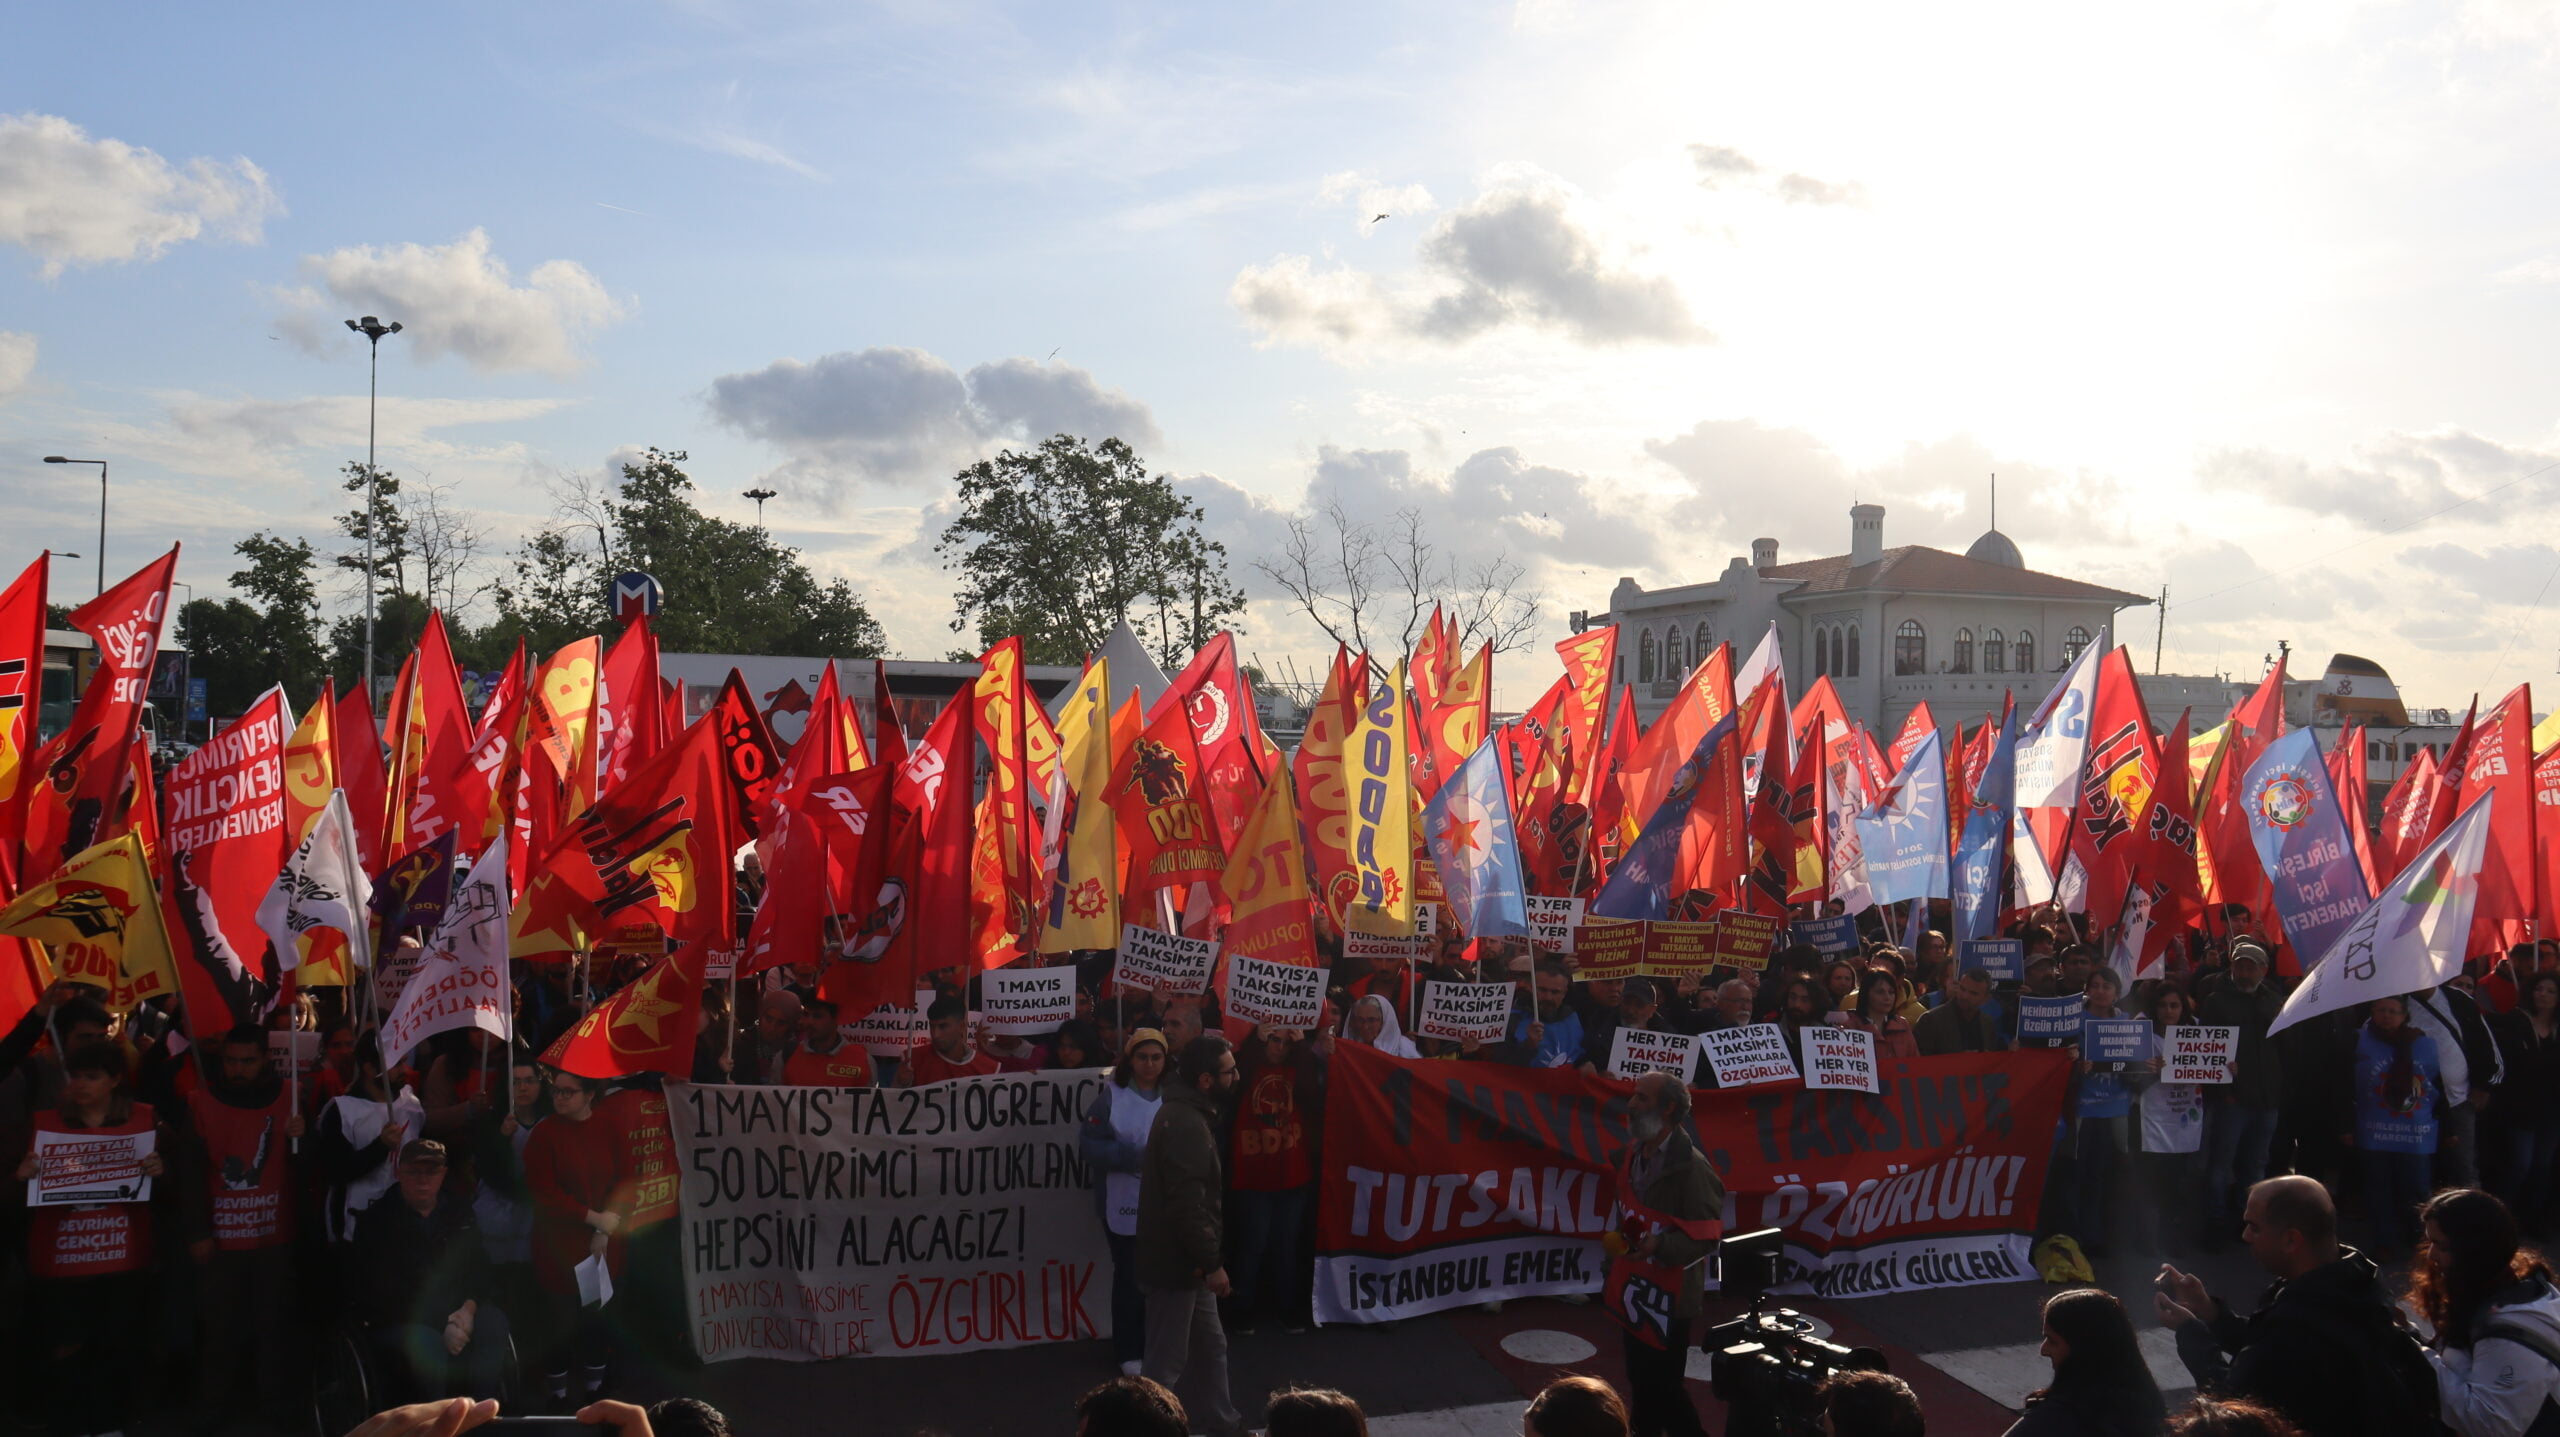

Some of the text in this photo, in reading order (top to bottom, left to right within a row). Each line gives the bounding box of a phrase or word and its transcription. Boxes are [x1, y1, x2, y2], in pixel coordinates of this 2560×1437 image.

[1543, 900, 1572, 911] YER
[1529, 911, 1567, 924] KSİM
[1538, 926, 1568, 937] YER
[1588, 927, 1625, 940] FİLİSTİN
[1673, 935, 1699, 944] MAYIS
[1132, 927, 1209, 954] 1 MAYIS'A
[1129, 942, 1206, 968] TAKSİM'E
[1594, 949, 1630, 962] BİZİM!
[1122, 954, 1205, 977] TUTSAKLARA
[1238, 958, 1245, 970] 1
[1248, 961, 1319, 983] MAYIS'A
[1584, 967, 1636, 979] PARTİZAN
[998, 978, 1061, 993] 1 MAYIS
[1237, 973, 1317, 998] TAKSİM'E
[1434, 984, 1507, 998] 1 MAYIS'A
[986, 995, 1070, 1010] TUTSAKLARI
[1231, 987, 1317, 1011] TUTSAKLARA
[1433, 997, 1505, 1013] TAKSİM'E
[987, 1011, 1071, 1025] ONURUMUZDUR
[1426, 1010, 1505, 1025] TUTSAKLARA
[1626, 1031, 1690, 1049] HER YER
[1707, 1025, 1776, 1044] 1 MAYIS'A
[1812, 1029, 1866, 1044] HER YER
[2175, 1028, 2230, 1039] HER YER
[1713, 1037, 1780, 1056] TAKSİM'E
[1816, 1043, 1866, 1059] TAKSİM
[2177, 1039, 2226, 1053] TAKSİM
[1627, 1047, 1684, 1065] TAKSİM
[1714, 1052, 1788, 1068] TUTSAKLARA
[2172, 1055, 2227, 1066] HER YER
[1620, 1060, 1650, 1073] HER
[1721, 1062, 1794, 1082] ÖZGÜRLÜK
[1815, 1058, 1869, 1073] HER YER
[2112, 1061, 2126, 1072] ESP
[2174, 1066, 2223, 1082] DİRENİŞ
[1820, 1070, 1869, 1090] DİRENİŞ
[689, 1088, 711, 1138] 1
[714, 1086, 892, 1138] MAYIS'TA
[1380, 1066, 1416, 1147] 1
[693, 1146, 745, 1208] 50
[755, 1144, 918, 1202] DEVRİMCİ
[213, 1190, 279, 1209] DEVRİMCİ
[1759, 1144, 2028, 1242] ÖZGÜRLÜK!
[57, 1214, 129, 1233] DEVRİMCİ
[213, 1208, 277, 1228] GENÇLİK
[56, 1230, 128, 1251] GENÇLİK
[693, 1209, 816, 1274] HEPSİNİ
[1348, 1255, 1492, 1311] İSTANBUL
[1503, 1246, 1591, 1287] EMEK,
[1906, 1242, 2019, 1286] GÜÇLERİ
[888, 1259, 1098, 1350] ÖZGÜRLÜK
